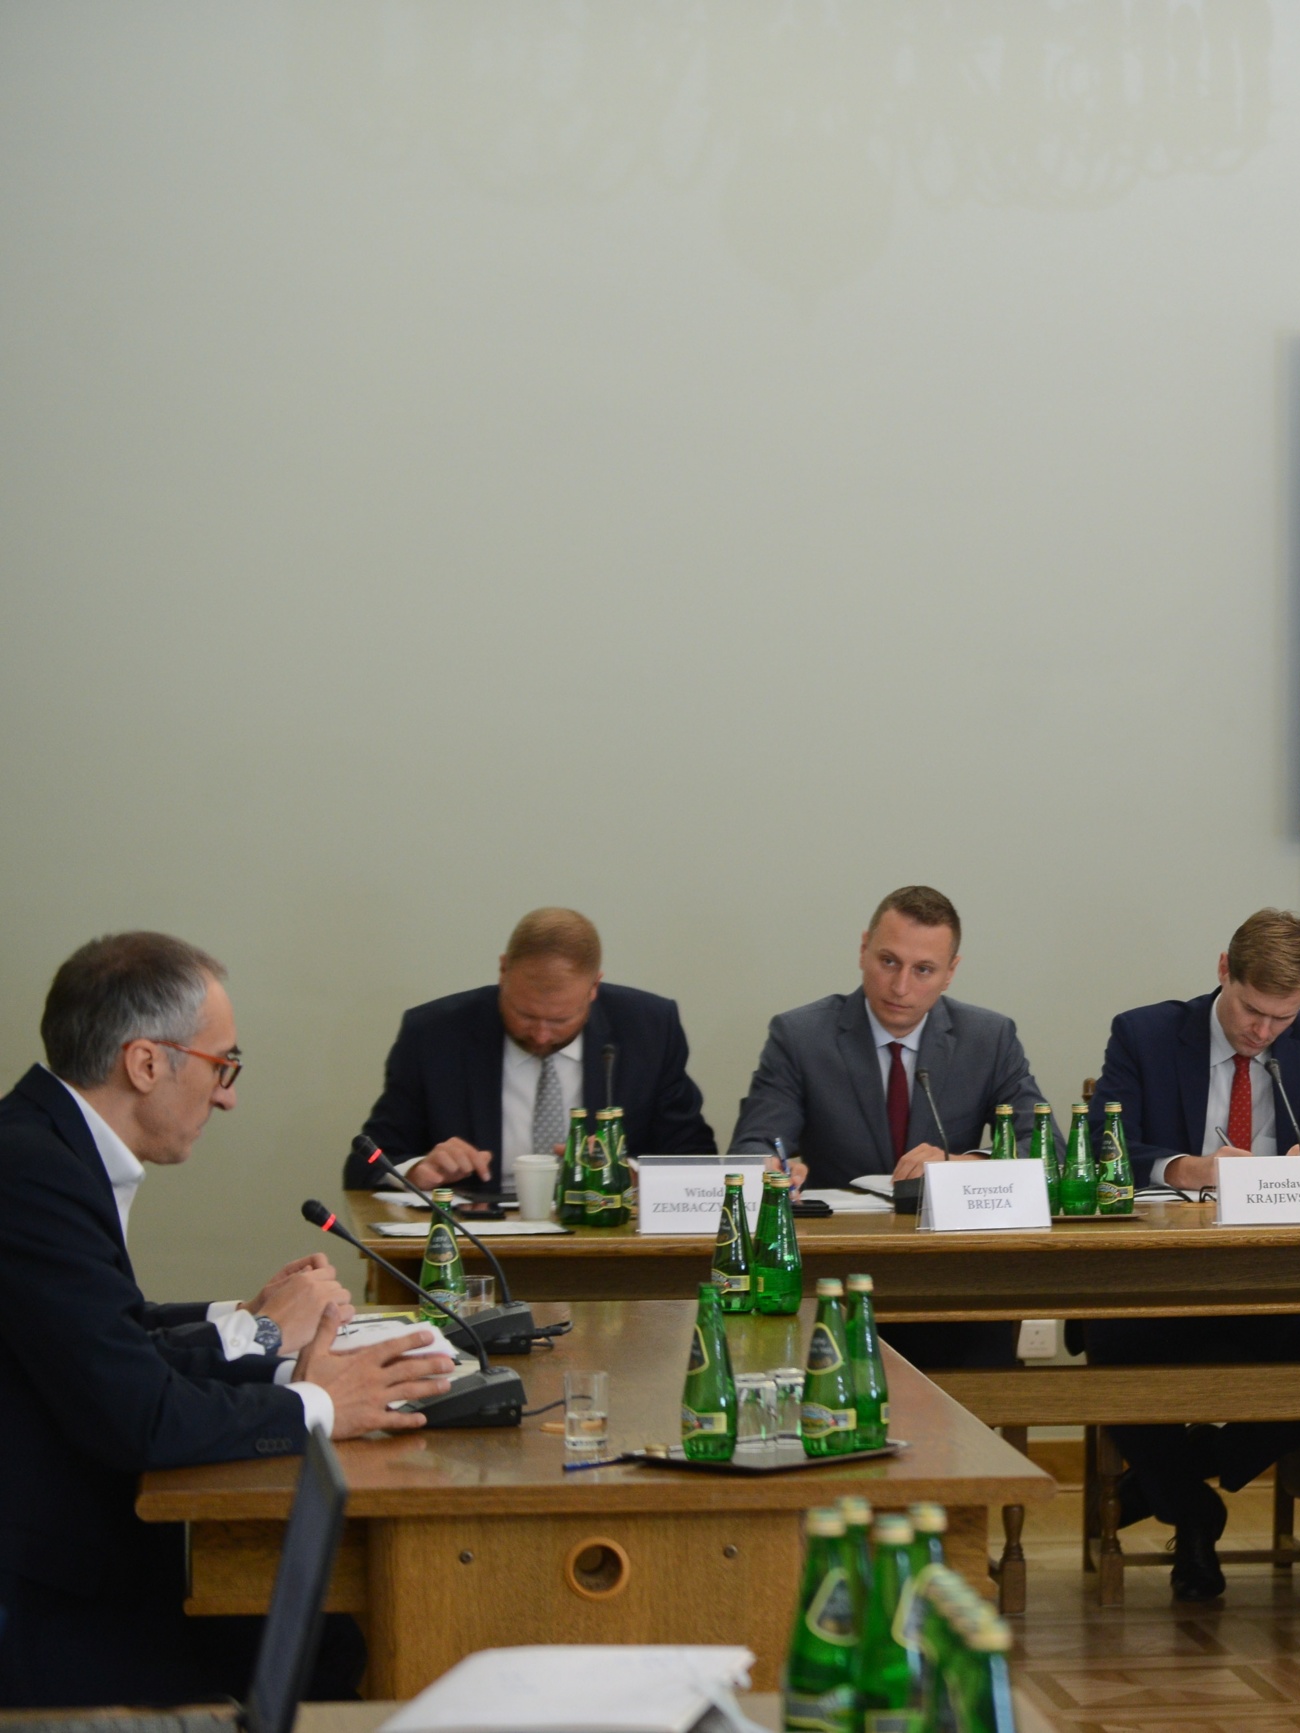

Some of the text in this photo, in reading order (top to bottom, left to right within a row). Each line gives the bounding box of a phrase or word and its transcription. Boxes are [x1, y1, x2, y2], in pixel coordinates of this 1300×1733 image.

[684, 1187, 724, 1198] Witold
[962, 1183, 1014, 1197] Krzysztof
[652, 1201, 756, 1213] ZEMBACZYKI
[967, 1198, 1012, 1210] BREJZA
